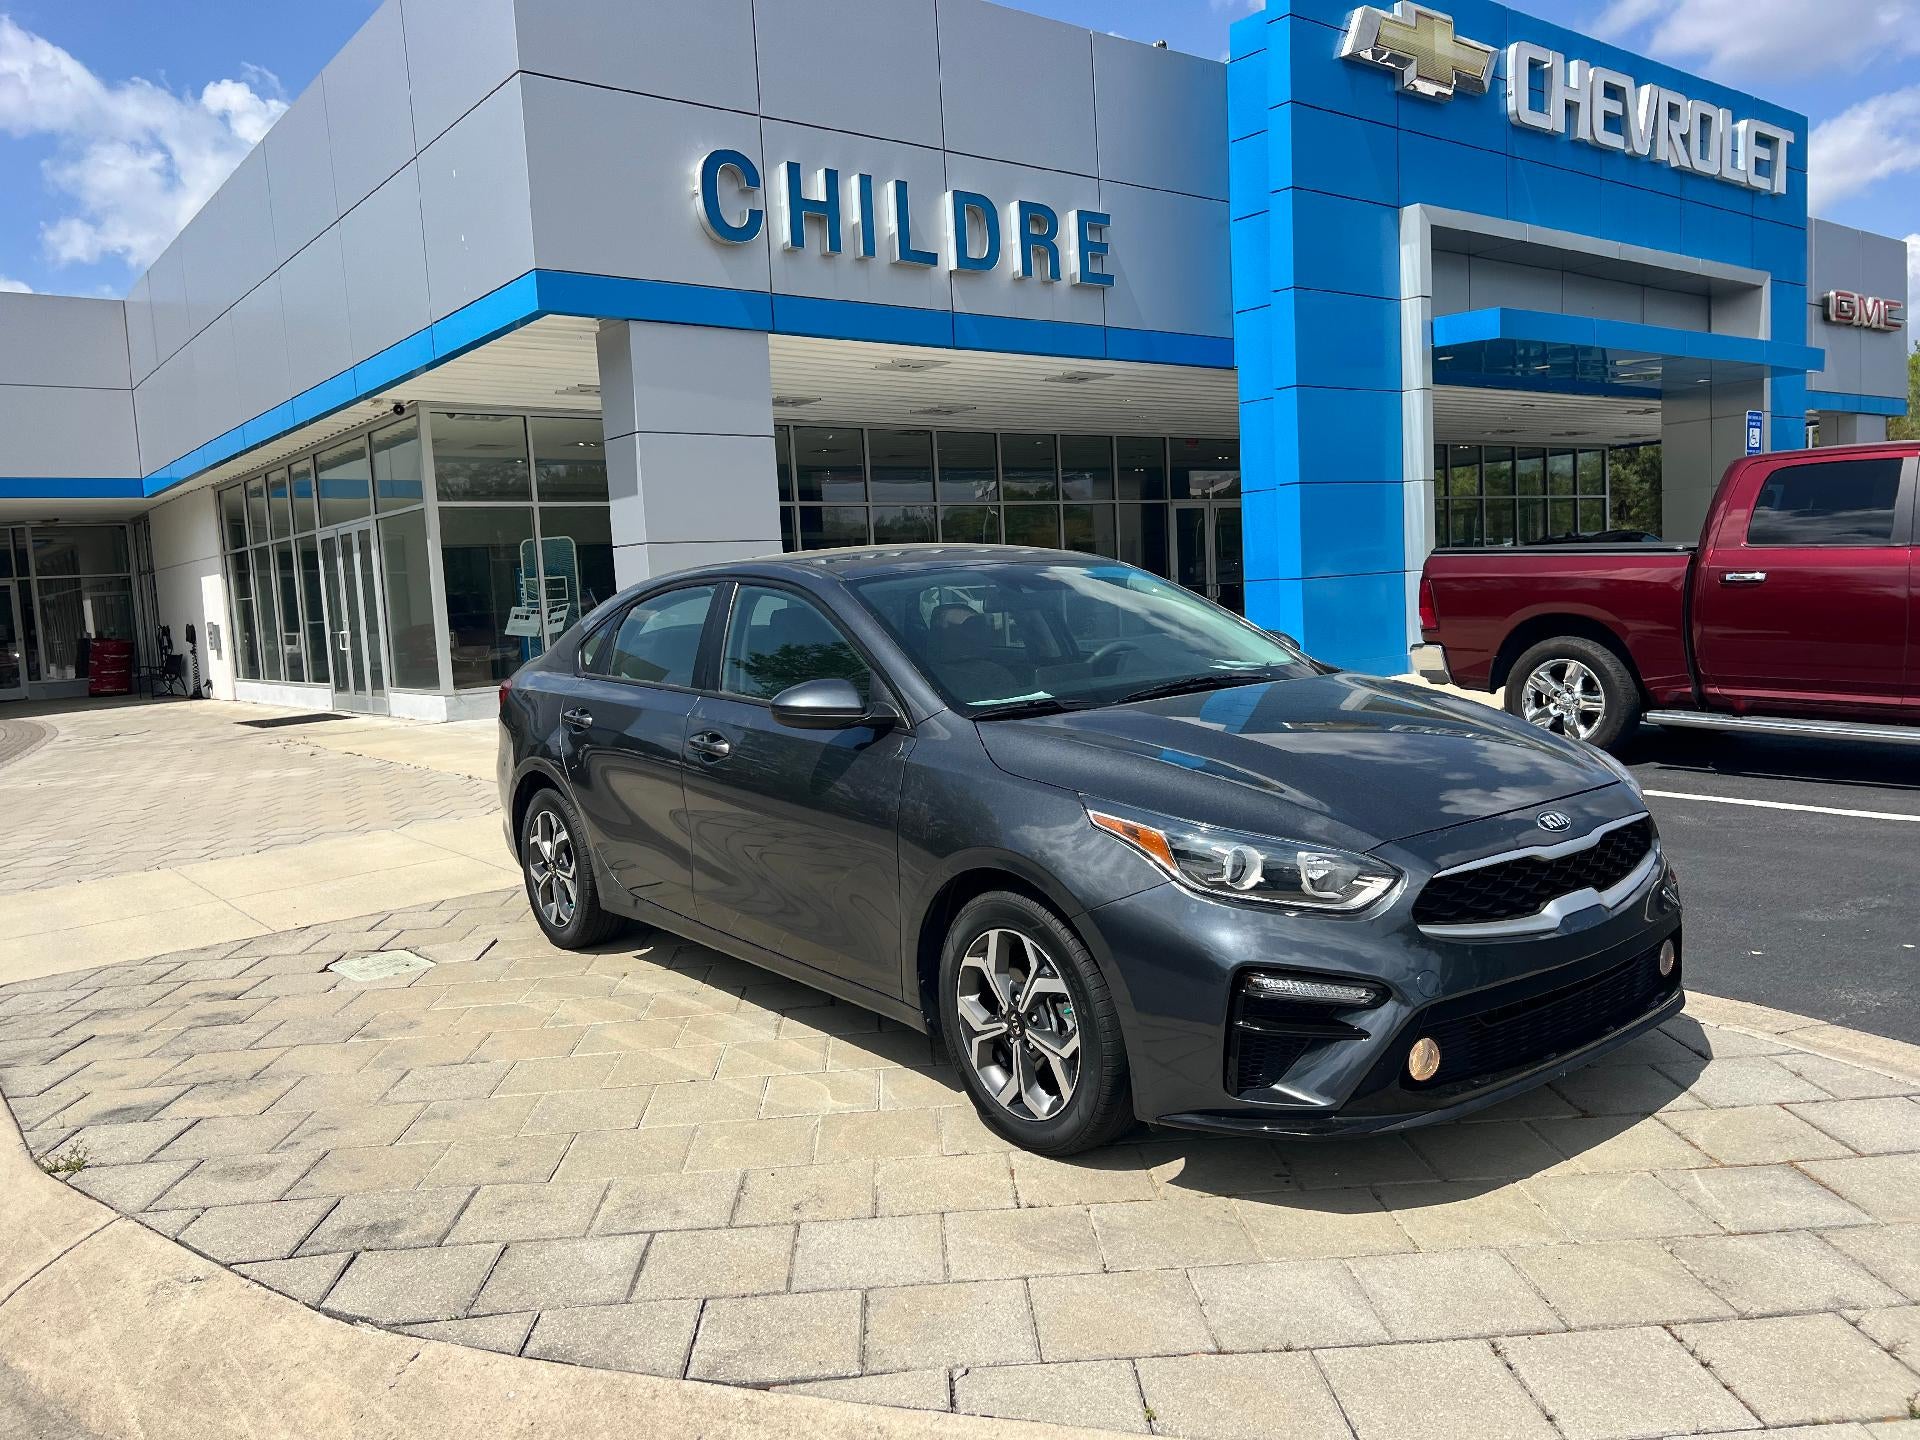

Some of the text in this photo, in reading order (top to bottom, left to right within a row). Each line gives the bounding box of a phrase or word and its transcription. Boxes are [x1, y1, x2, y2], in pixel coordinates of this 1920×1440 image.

[1506, 41, 1795, 195] CHEVROLET
[695, 149, 1115, 288] CHILDRE
[1826, 290, 1903, 332] GMC
[1540, 812, 1570, 828] KIA
